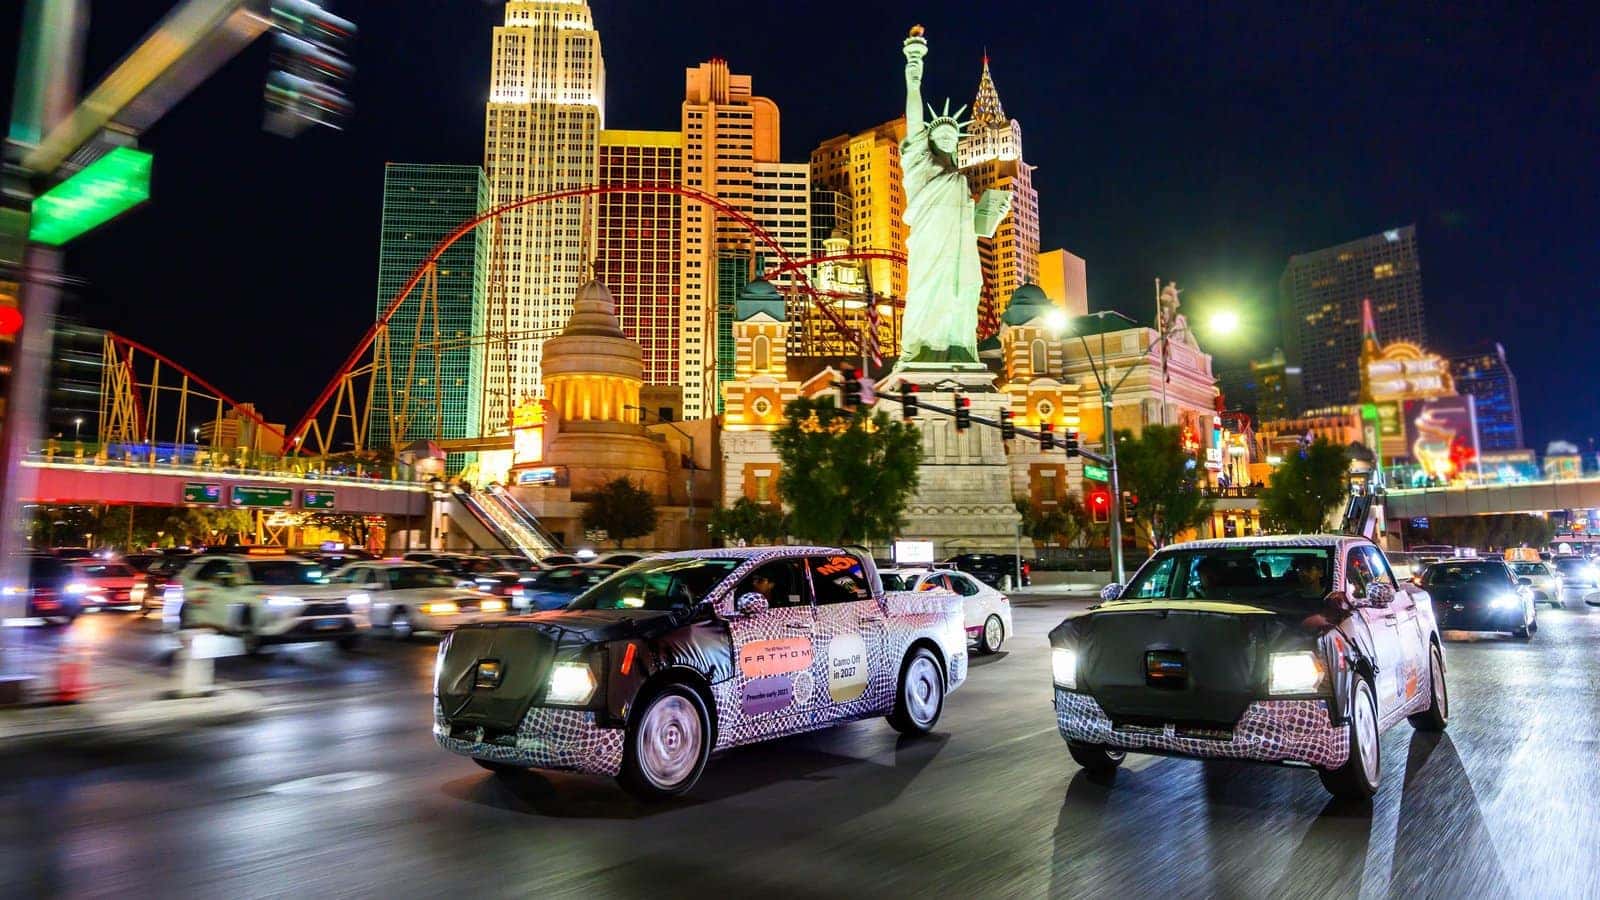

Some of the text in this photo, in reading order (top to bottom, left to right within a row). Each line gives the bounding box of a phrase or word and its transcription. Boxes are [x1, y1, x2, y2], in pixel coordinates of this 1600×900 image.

[744, 650, 811, 664] FATHOM
[833, 654, 861, 667] Camo Off
[833, 666, 856, 680] in 2027
